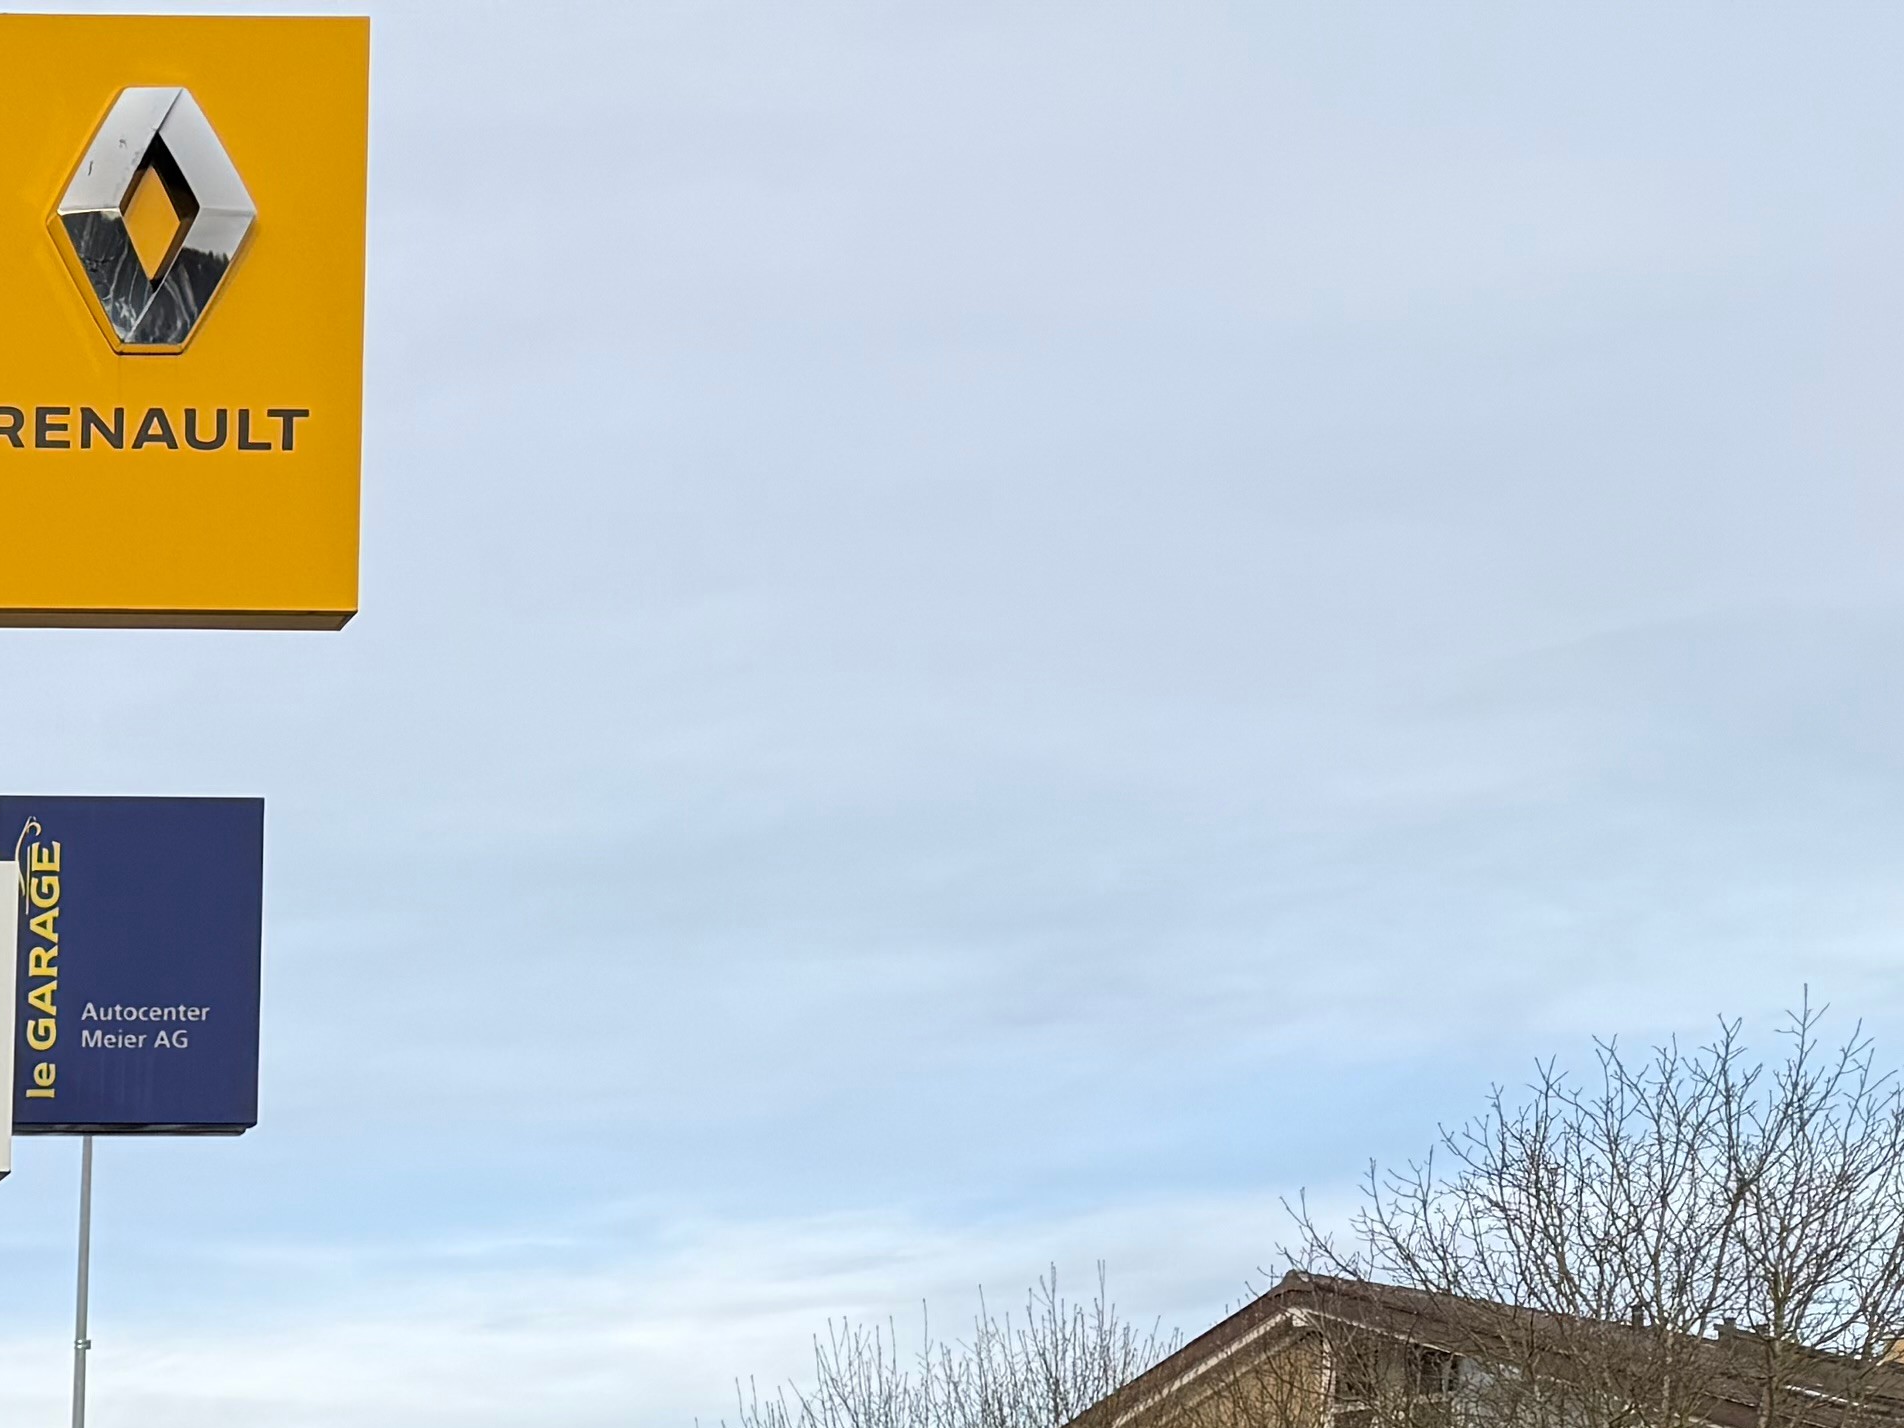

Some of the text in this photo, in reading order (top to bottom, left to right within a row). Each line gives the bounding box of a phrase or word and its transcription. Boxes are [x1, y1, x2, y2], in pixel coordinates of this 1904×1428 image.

[25, 839, 62, 1099] le GARAGE
[80, 1002, 211, 1021] Autocenter
[80, 1029, 189, 1049] Meier AG
